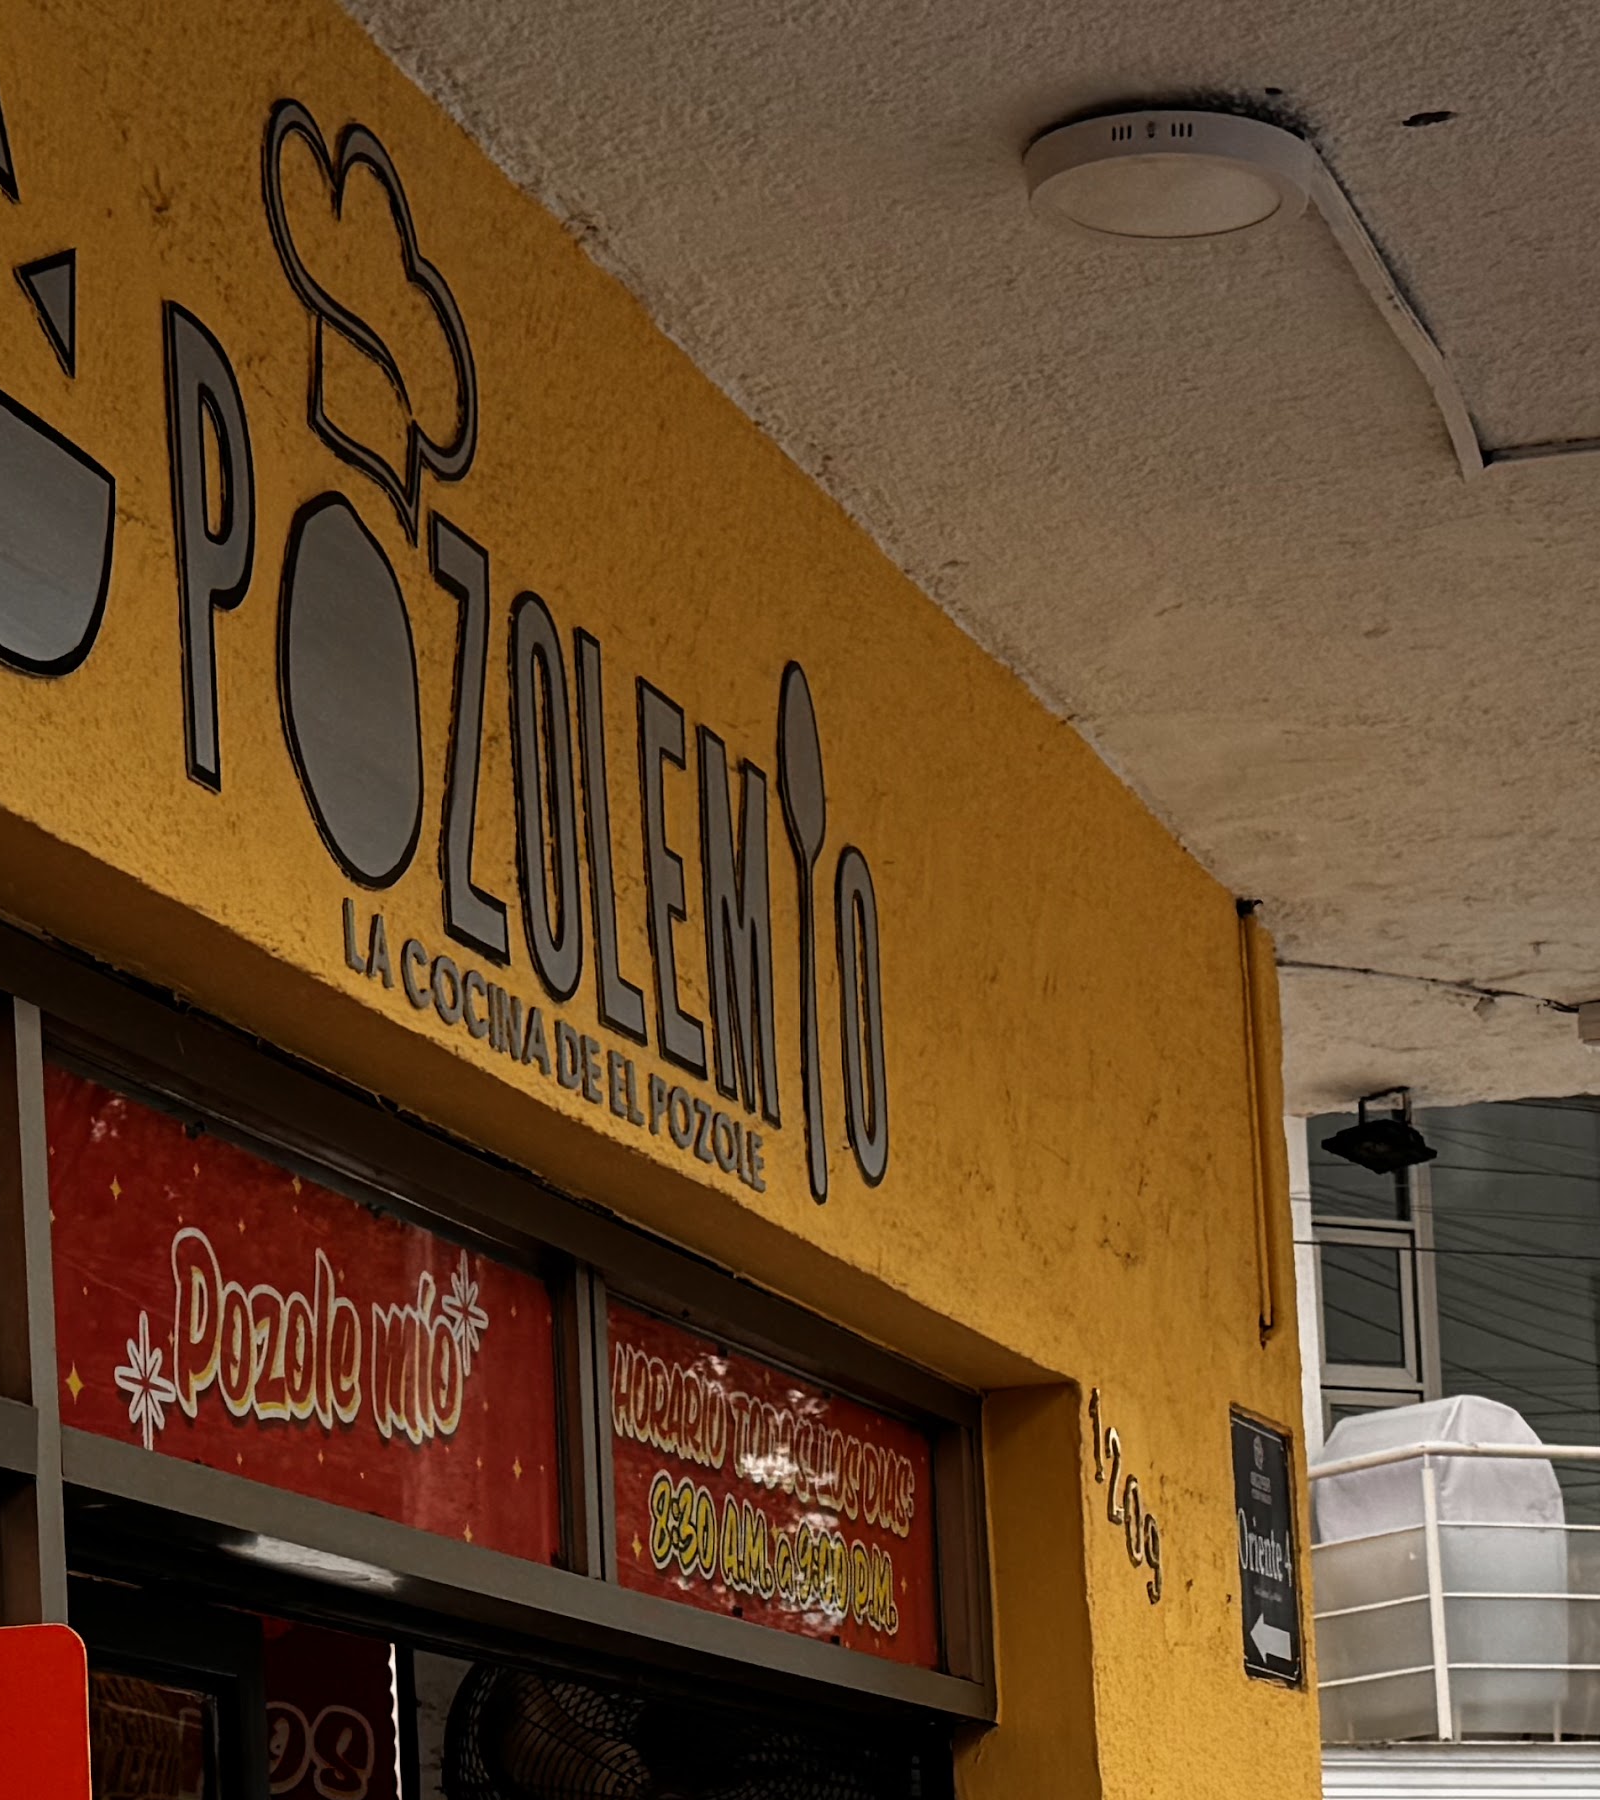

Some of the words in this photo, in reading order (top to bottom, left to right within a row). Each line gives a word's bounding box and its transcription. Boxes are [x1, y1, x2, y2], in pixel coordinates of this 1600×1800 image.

[342, 897, 394, 990] LA
[401, 938, 551, 1076] COCINA
[555, 1018, 603, 1105] DE
[607, 1049, 645, 1128] EL
[648, 1072, 767, 1194] POZOLE
[171, 1227, 362, 1430] Pozole
[612, 1342, 727, 1469] HORARIO
[649, 1469, 718, 1580] 8:30
[720, 1492, 776, 1600] A.M.
[776, 1532, 796, 1602] a
[795, 1518, 850, 1620] 9:00
[1088, 1386, 1161, 1605] 1209
[1238, 1508, 1283, 1582] Oriente
[1285, 1530, 1293, 1588] 4
